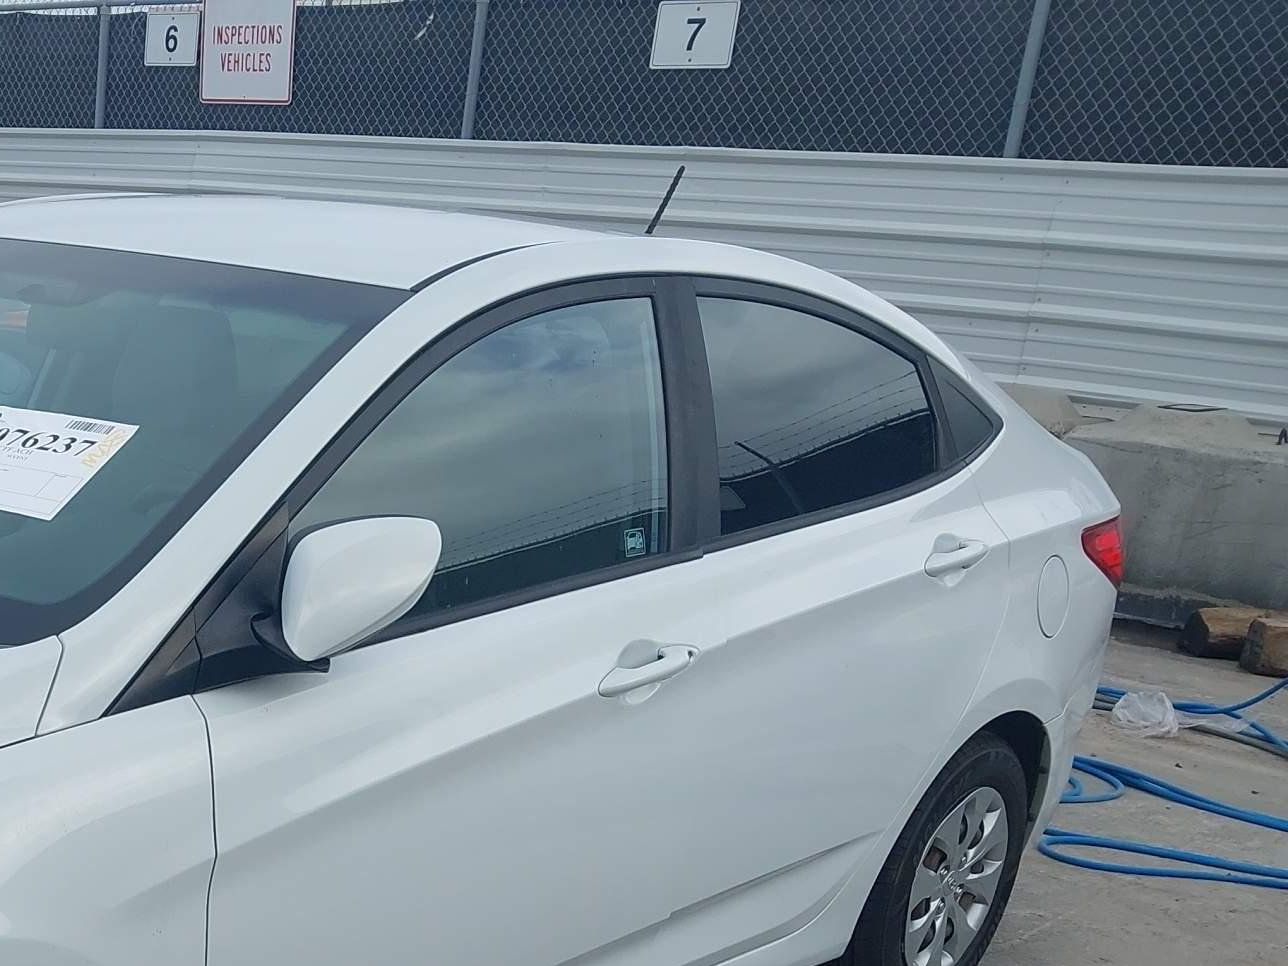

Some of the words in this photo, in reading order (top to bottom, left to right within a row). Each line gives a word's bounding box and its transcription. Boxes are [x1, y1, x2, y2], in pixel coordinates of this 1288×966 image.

[165, 24, 179, 53] 6
[212, 25, 283, 45] INSPECTIONS
[686, 17, 707, 51] 7
[220, 53, 272, 73] VEHICLES
